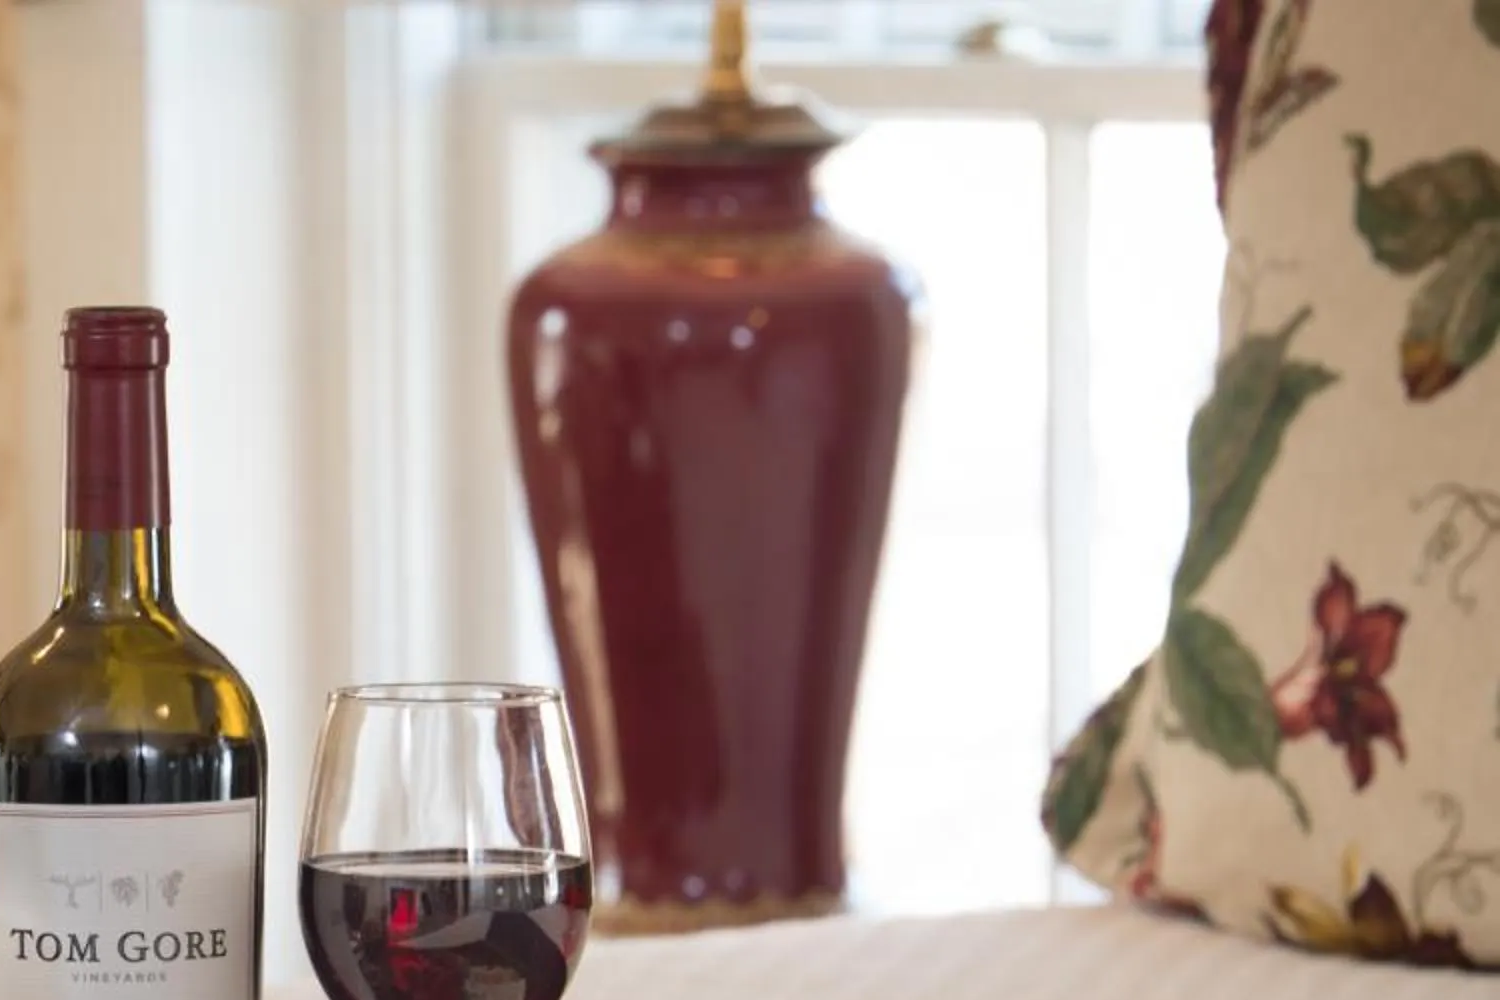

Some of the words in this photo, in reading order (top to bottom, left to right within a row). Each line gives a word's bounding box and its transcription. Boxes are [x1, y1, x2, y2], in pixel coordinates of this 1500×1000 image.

[9, 928, 100, 962] TOM
[116, 929, 228, 962] GORE
[71, 972, 167, 983] VINEYARDS
